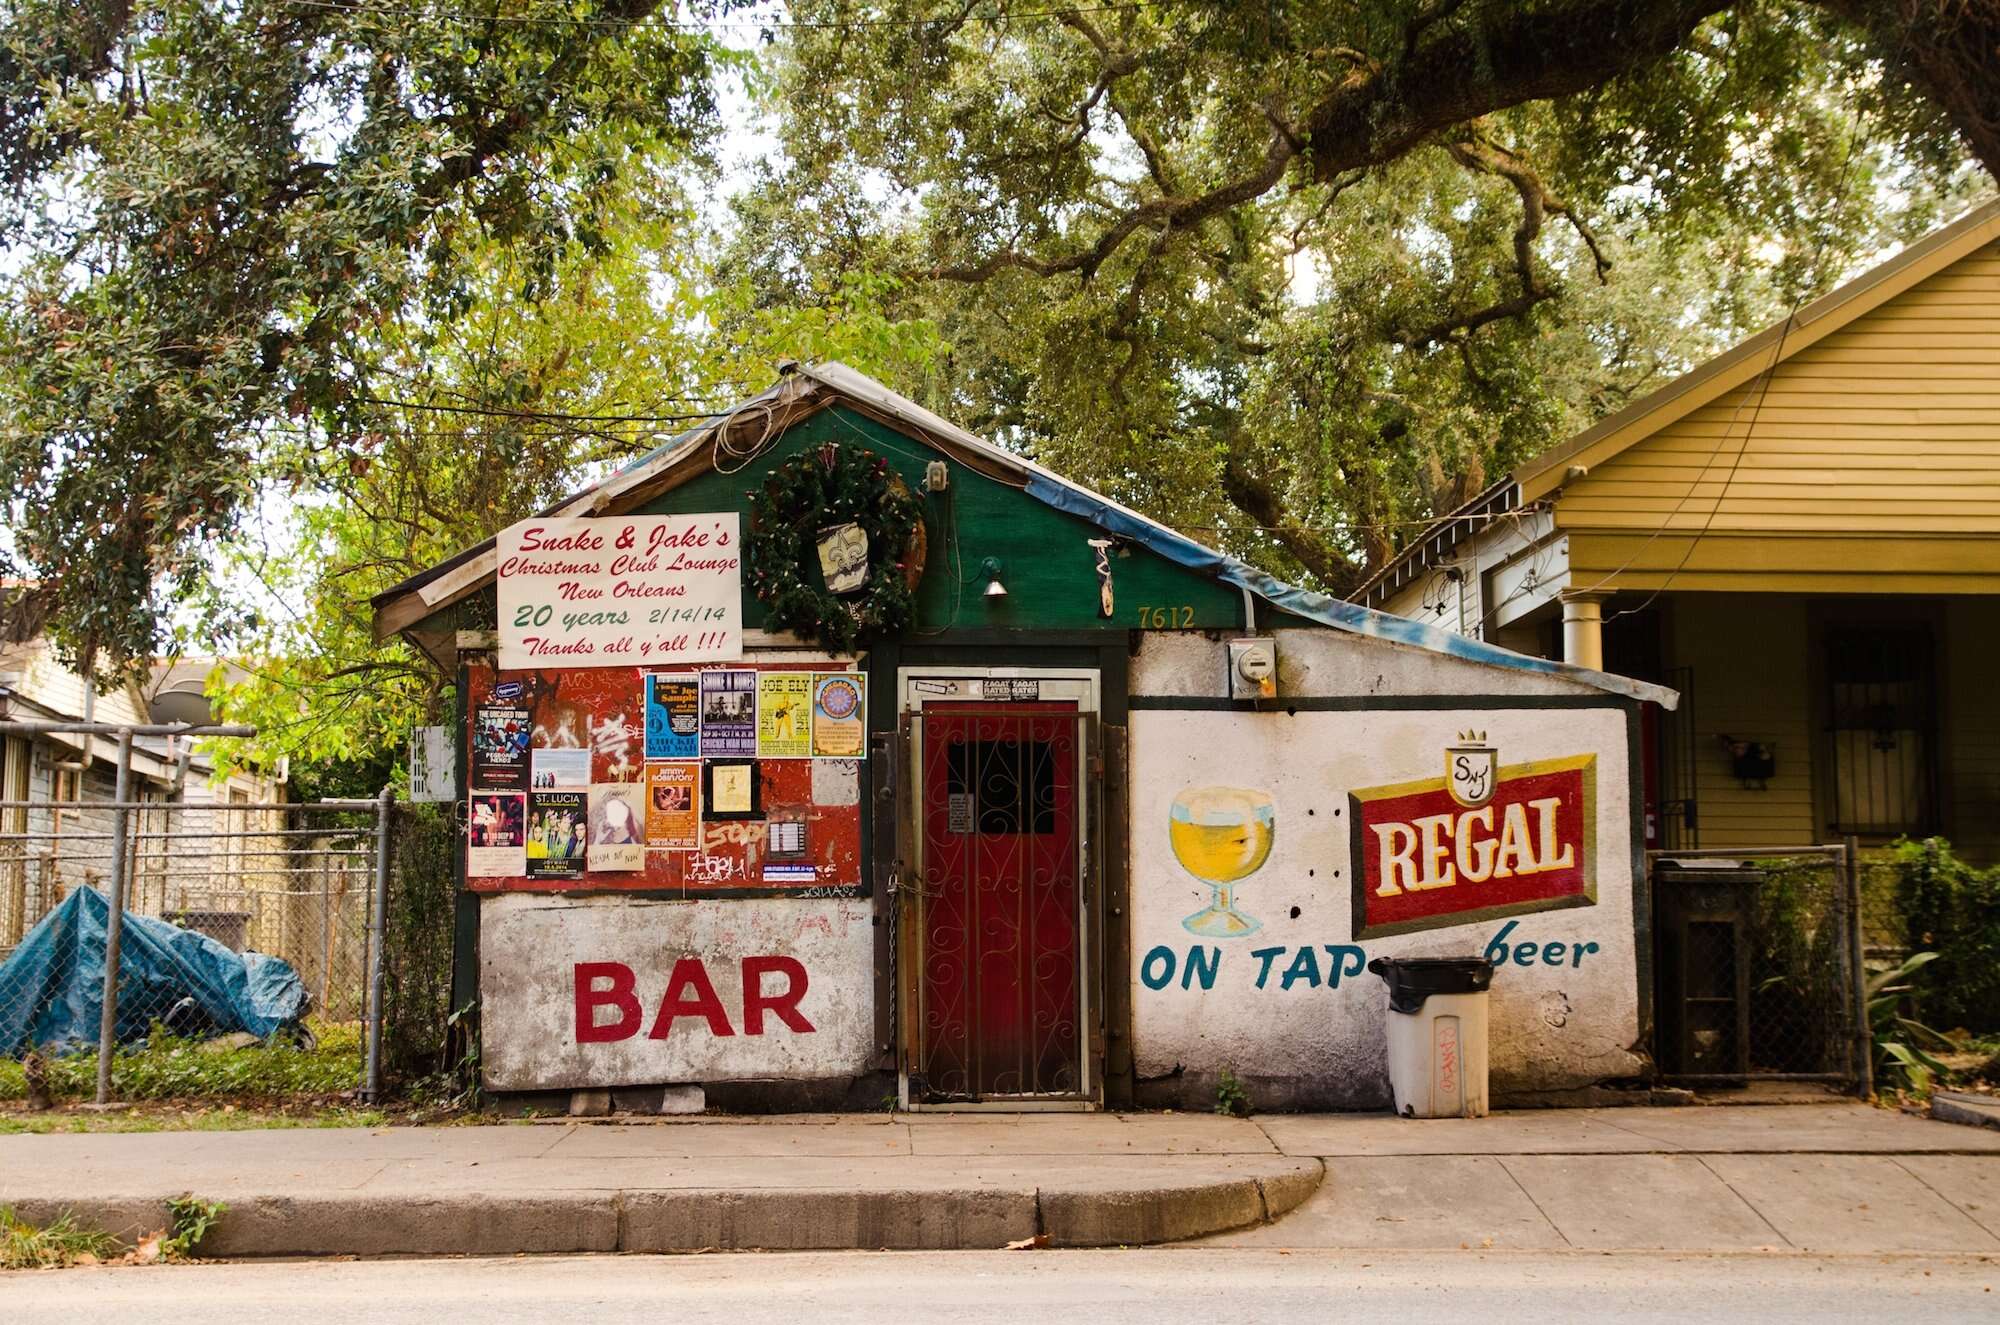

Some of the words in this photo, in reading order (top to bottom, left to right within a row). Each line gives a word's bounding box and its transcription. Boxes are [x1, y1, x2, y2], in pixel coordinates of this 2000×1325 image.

[519, 528, 604, 551] Snake
[615, 526, 635, 549] &
[646, 523, 730, 556] Jake's
[500, 557, 601, 578] Christmas
[610, 555, 659, 576] Club
[666, 553, 738, 574] Lounge
[557, 582, 604, 600] New
[613, 580, 687, 599] Orleans
[514, 605, 552, 628] 20
[563, 608, 630, 632] years
[649, 607, 726, 624] 2/14/14
[1139, 606, 1195, 628] 7612
[523, 637, 595, 656] Thanks
[604, 636, 633, 653] all
[640, 633, 689, 656] y'all
[698, 632, 726, 649] !!!
[761, 680, 783, 691] JOE
[789, 680, 809, 691] ELY
[661, 694, 697, 703] Sample
[536, 795, 550, 803] ST.
[552, 794, 580, 803] LUCIA
[1369, 797, 1574, 897] REGAL
[1482, 920, 1600, 968] beer
[1141, 945, 1222, 991] ON
[1251, 944, 1366, 991] TAP
[574, 956, 815, 1044] BAR
